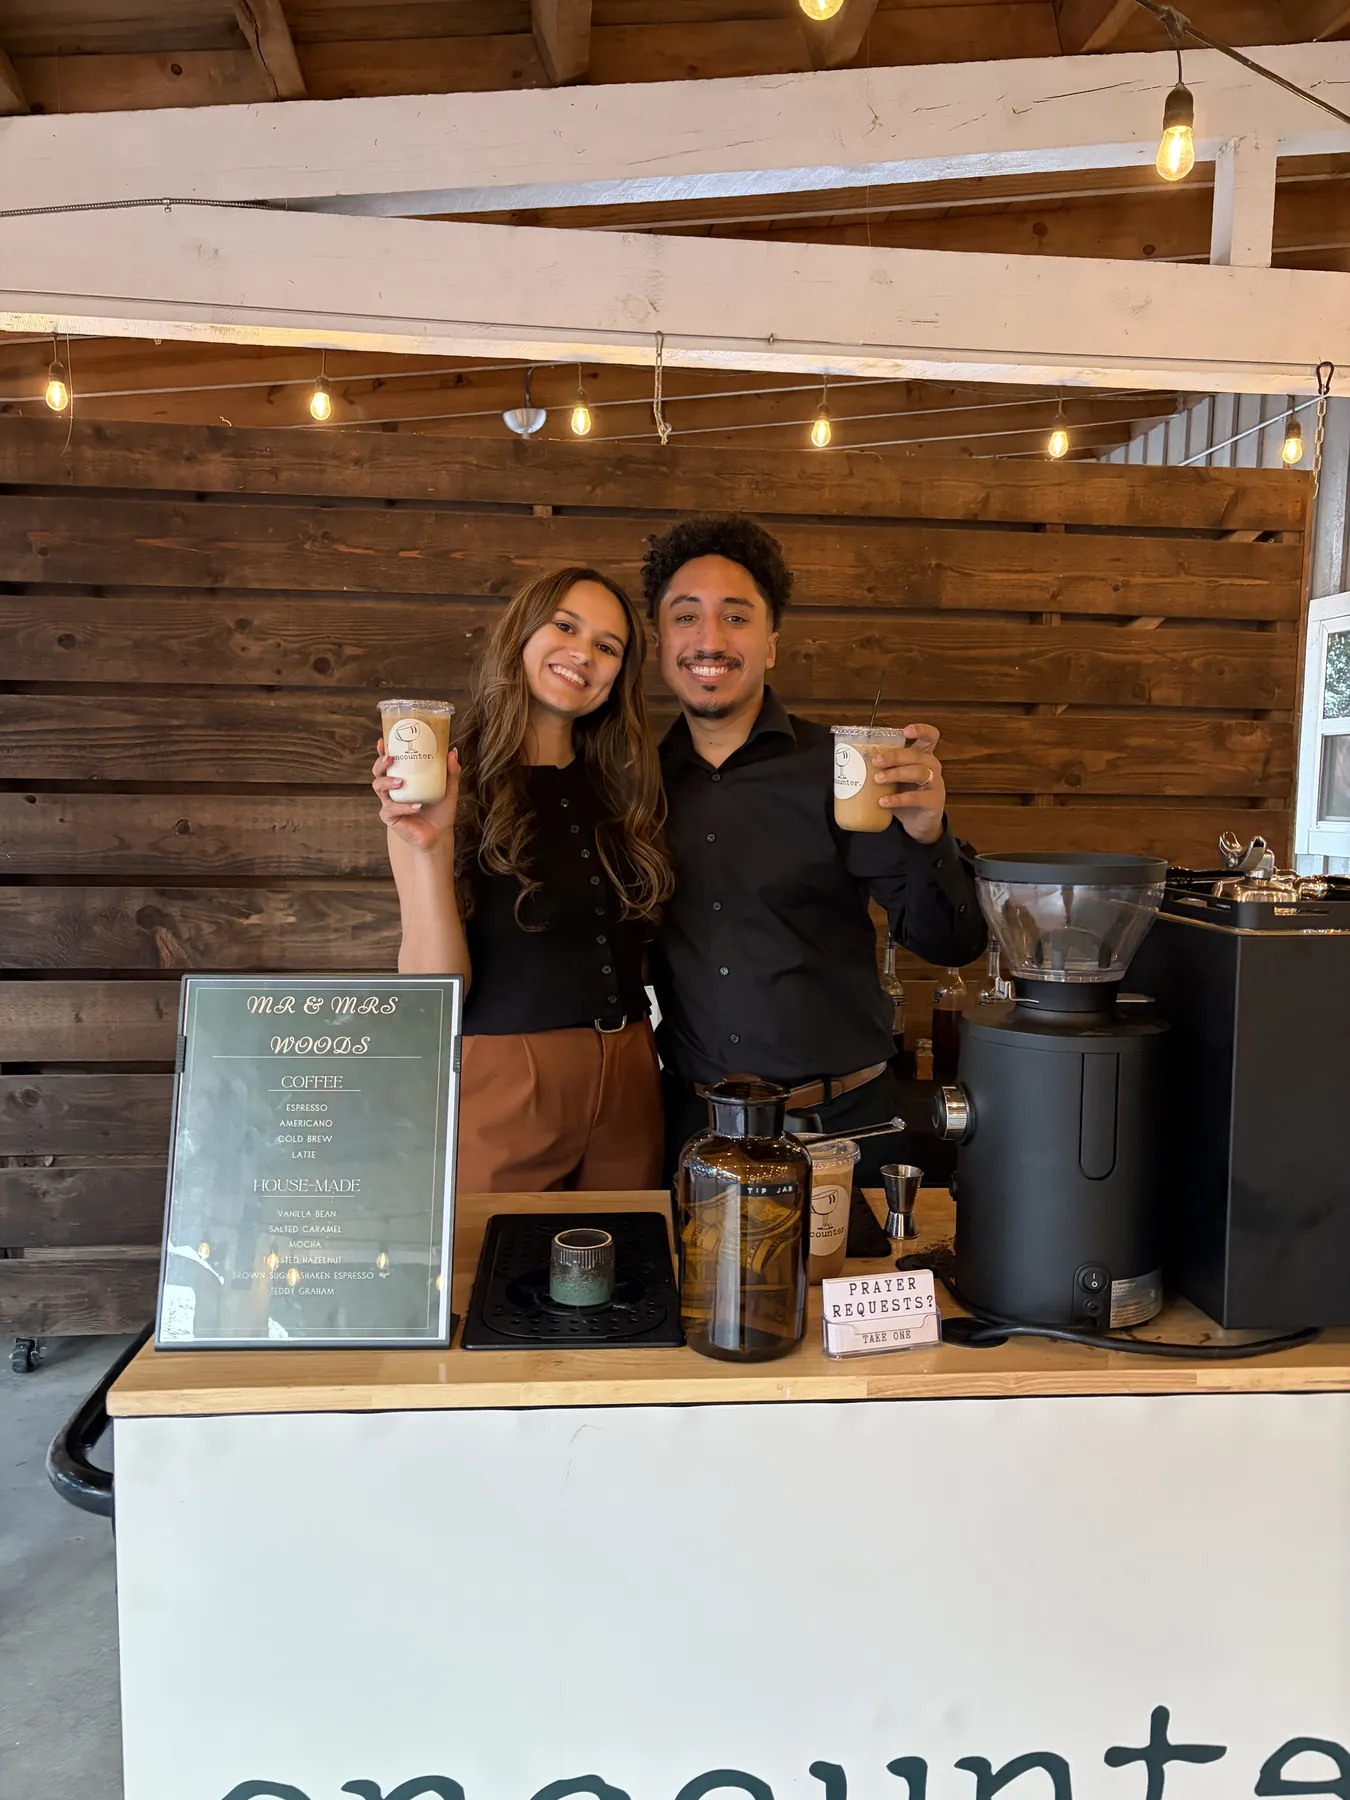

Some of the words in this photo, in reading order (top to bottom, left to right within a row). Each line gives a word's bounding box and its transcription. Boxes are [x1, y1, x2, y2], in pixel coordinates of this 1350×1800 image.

[247, 996, 295, 1015] MR
[303, 996, 324, 1014] &
[331, 996, 399, 1015] MRS
[270, 1036, 371, 1055] WOODS
[281, 1075, 343, 1089] COFFEE
[286, 1103, 328, 1112] ESPRESSO
[279, 1119, 333, 1128] AMERICANO
[278, 1135, 304, 1143] COLD
[307, 1135, 333, 1143] BREW
[292, 1150, 316, 1159] LATTE
[253, 1178, 361, 1192] HOUSE-MADE
[747, 1187, 767, 1195] TIP
[776, 1185, 793, 1194] JAR
[277, 1210, 312, 1218] VANILLA
[315, 1210, 337, 1218] BEAN
[269, 1225, 298, 1234] SALTED
[302, 1225, 342, 1234] CARAMEL
[288, 1240, 321, 1249] MOCHA
[263, 1256, 299, 1265] TSTED
[302, 1256, 342, 1264] HAZELNUT
[300, 1271, 331, 1280] SHAKEN
[334, 1271, 374, 1280] ESPRESSO
[849, 1277, 917, 1296] PRAYER
[270, 1287, 295, 1295] TEDDY
[299, 1287, 335, 1296] GRAHAM
[832, 1295, 934, 1318] REQUESTS?
[862, 1333, 887, 1344] TAKE
[893, 1330, 912, 1341] ONE
